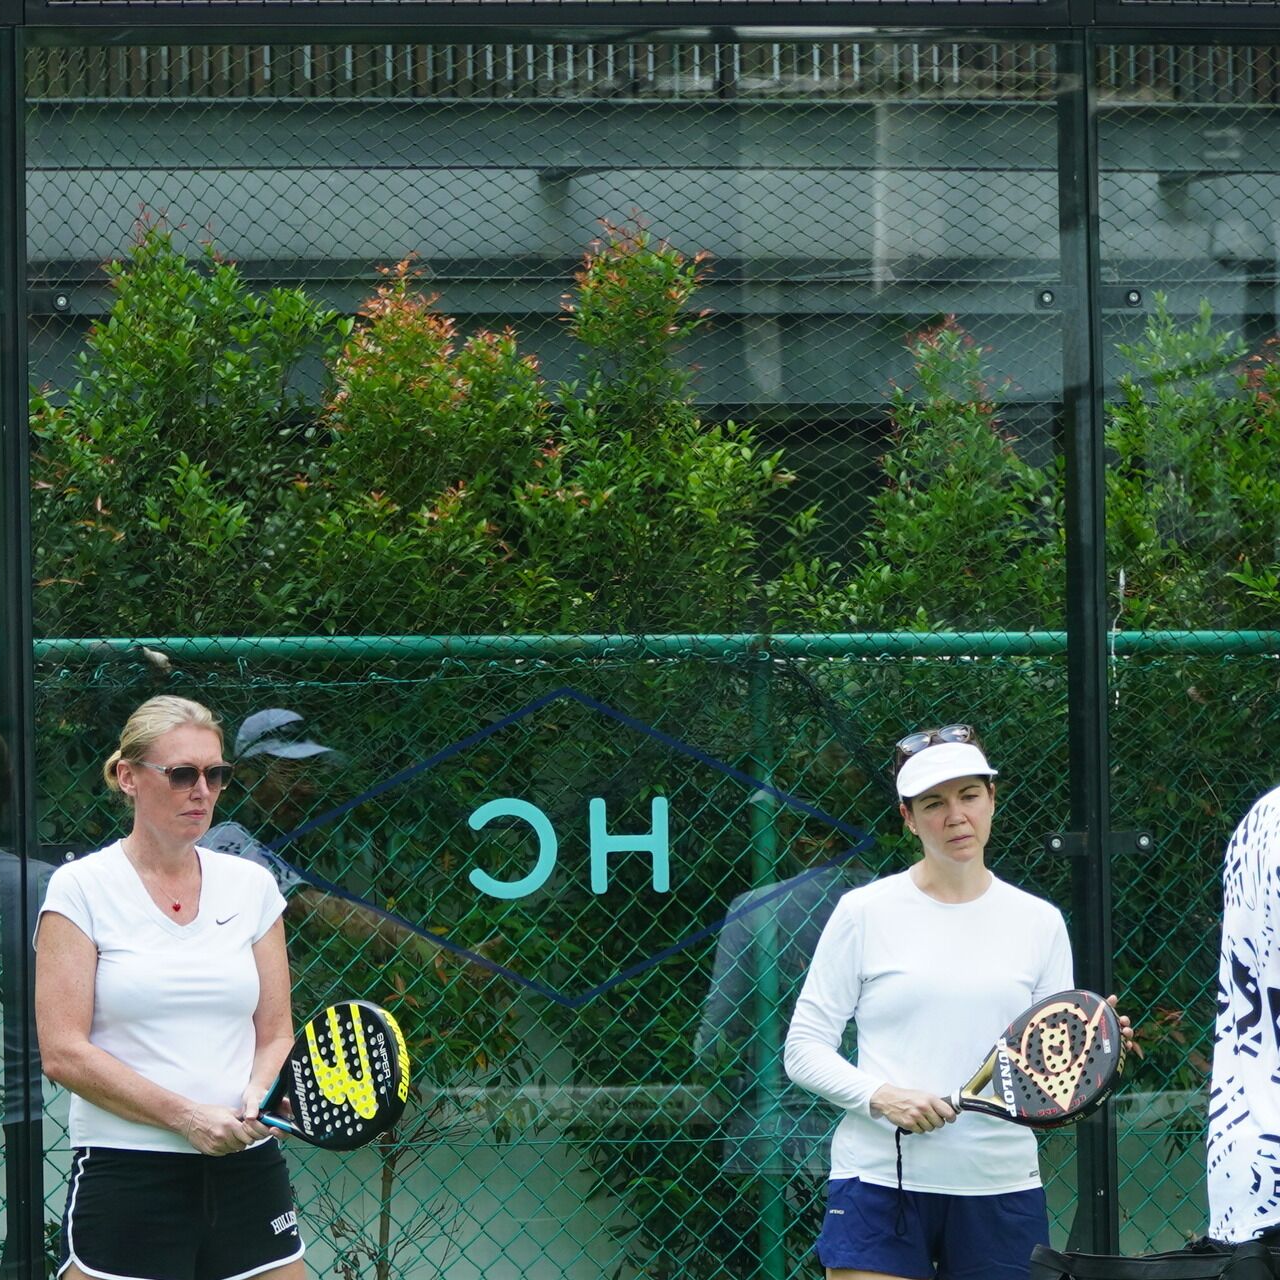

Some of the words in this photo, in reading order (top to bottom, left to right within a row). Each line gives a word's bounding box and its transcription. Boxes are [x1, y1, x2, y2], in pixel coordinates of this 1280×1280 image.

[376, 1032, 392, 1079] SNIPER
[997, 1038, 1018, 1117] DUNLOP
[291, 1059, 315, 1137] Bullpadel
